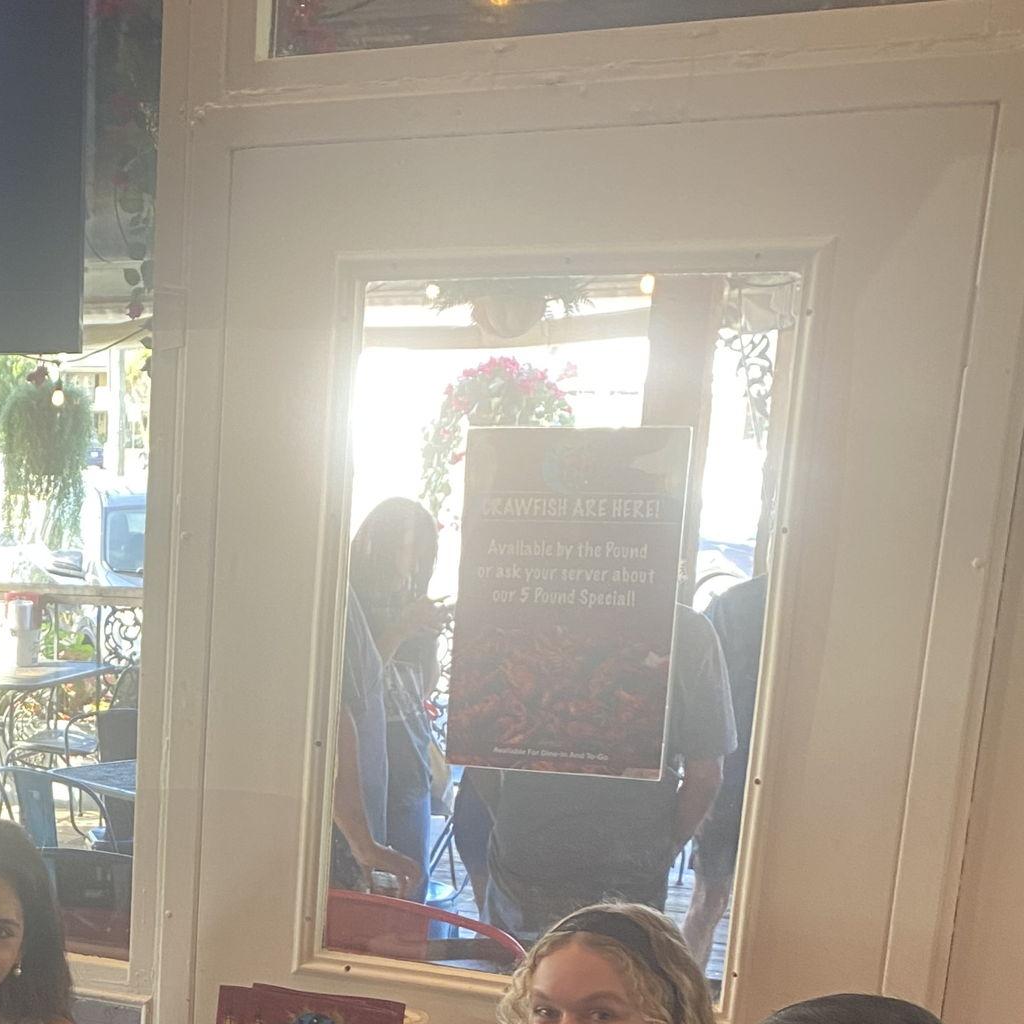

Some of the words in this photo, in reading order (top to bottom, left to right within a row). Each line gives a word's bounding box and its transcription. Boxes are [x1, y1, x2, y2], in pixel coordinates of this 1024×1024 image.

[481, 496, 567, 517] CRAWFISH
[573, 498, 608, 517] ARE
[611, 498, 660, 518] HERE!
[488, 539, 553, 557] Available
[557, 542, 575, 559] by
[577, 542, 601, 558] the
[606, 541, 648, 559] Pound
[478, 566, 494, 579] or
[495, 564, 521, 579] ask
[525, 567, 558, 582] your
[561, 568, 608, 582] server
[612, 567, 656, 584] about
[492, 589, 516, 602] our
[520, 586, 531, 603] 5
[534, 587, 575, 605] Pound
[579, 589, 636, 608] Special!
